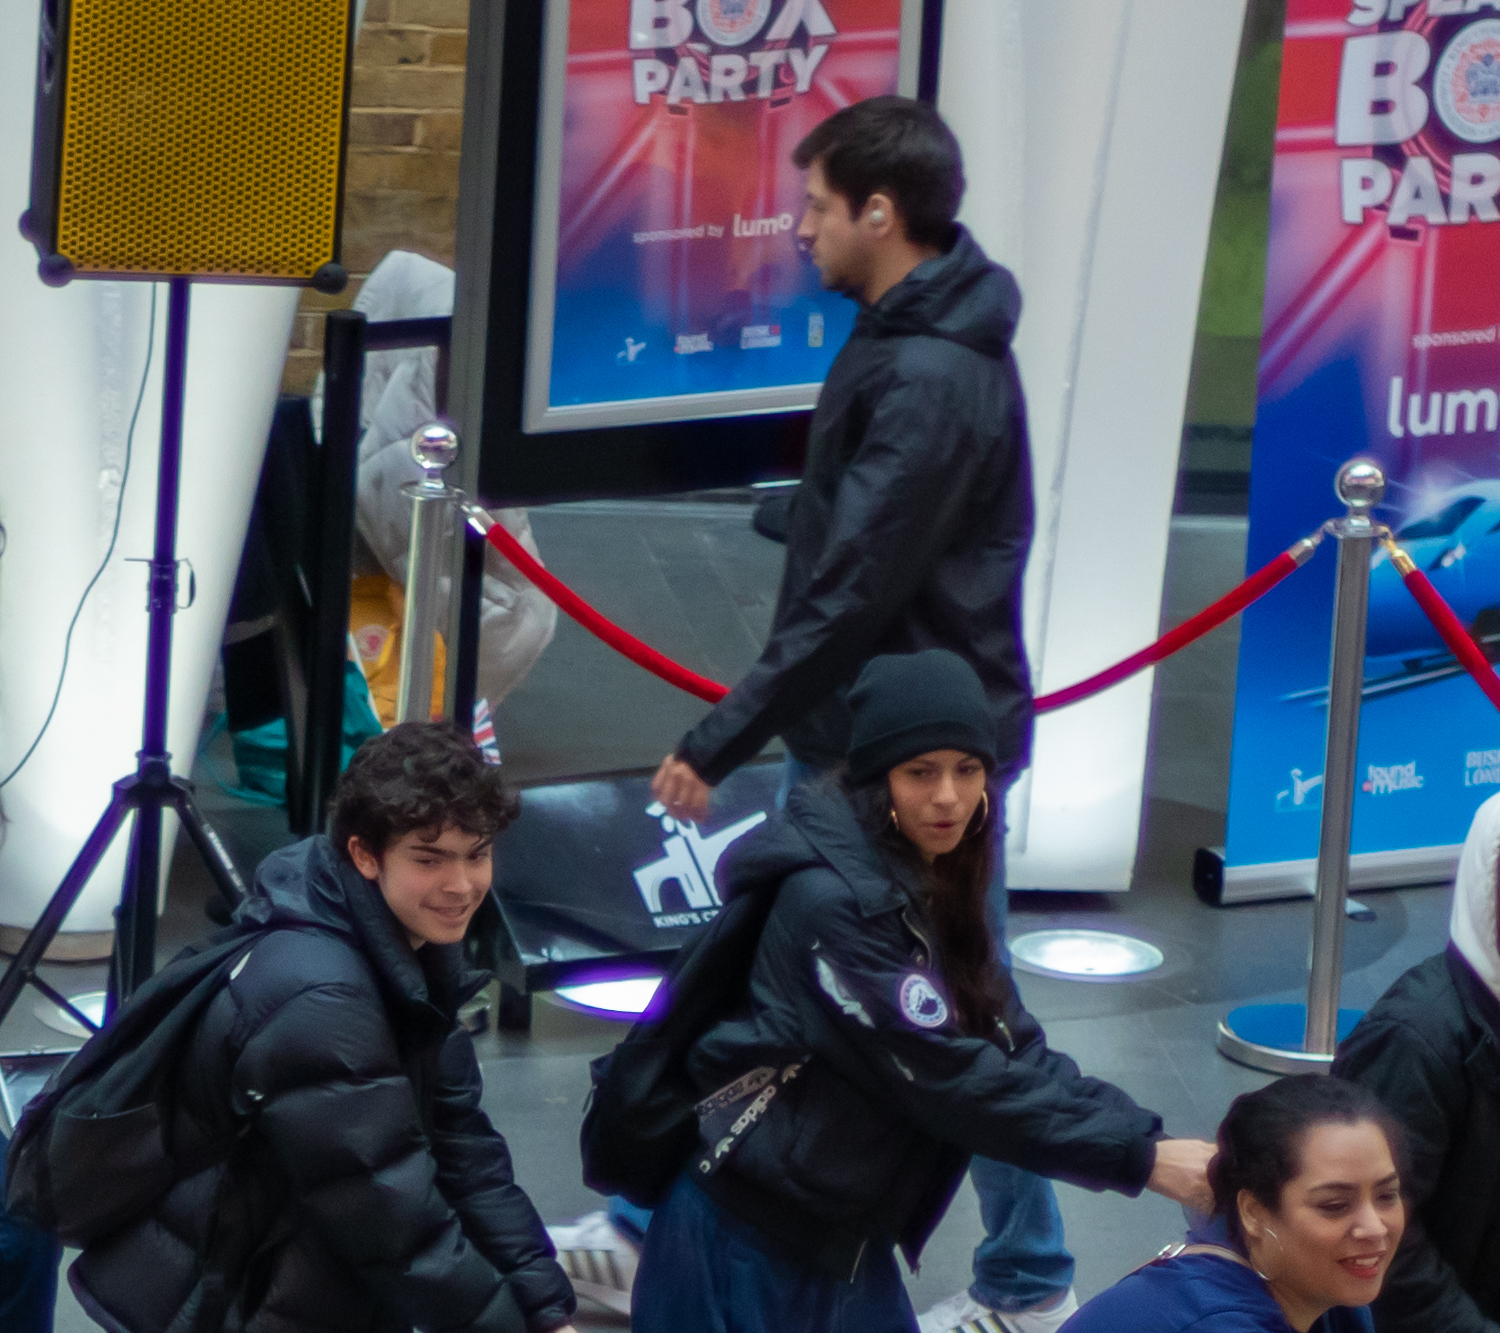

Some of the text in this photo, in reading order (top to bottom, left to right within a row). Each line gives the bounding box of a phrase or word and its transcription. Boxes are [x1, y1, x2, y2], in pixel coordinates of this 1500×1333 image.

[632, 44, 830, 105] PARTY
[732, 213, 794, 239] lumo
[729, 1085, 777, 1135] adidas
